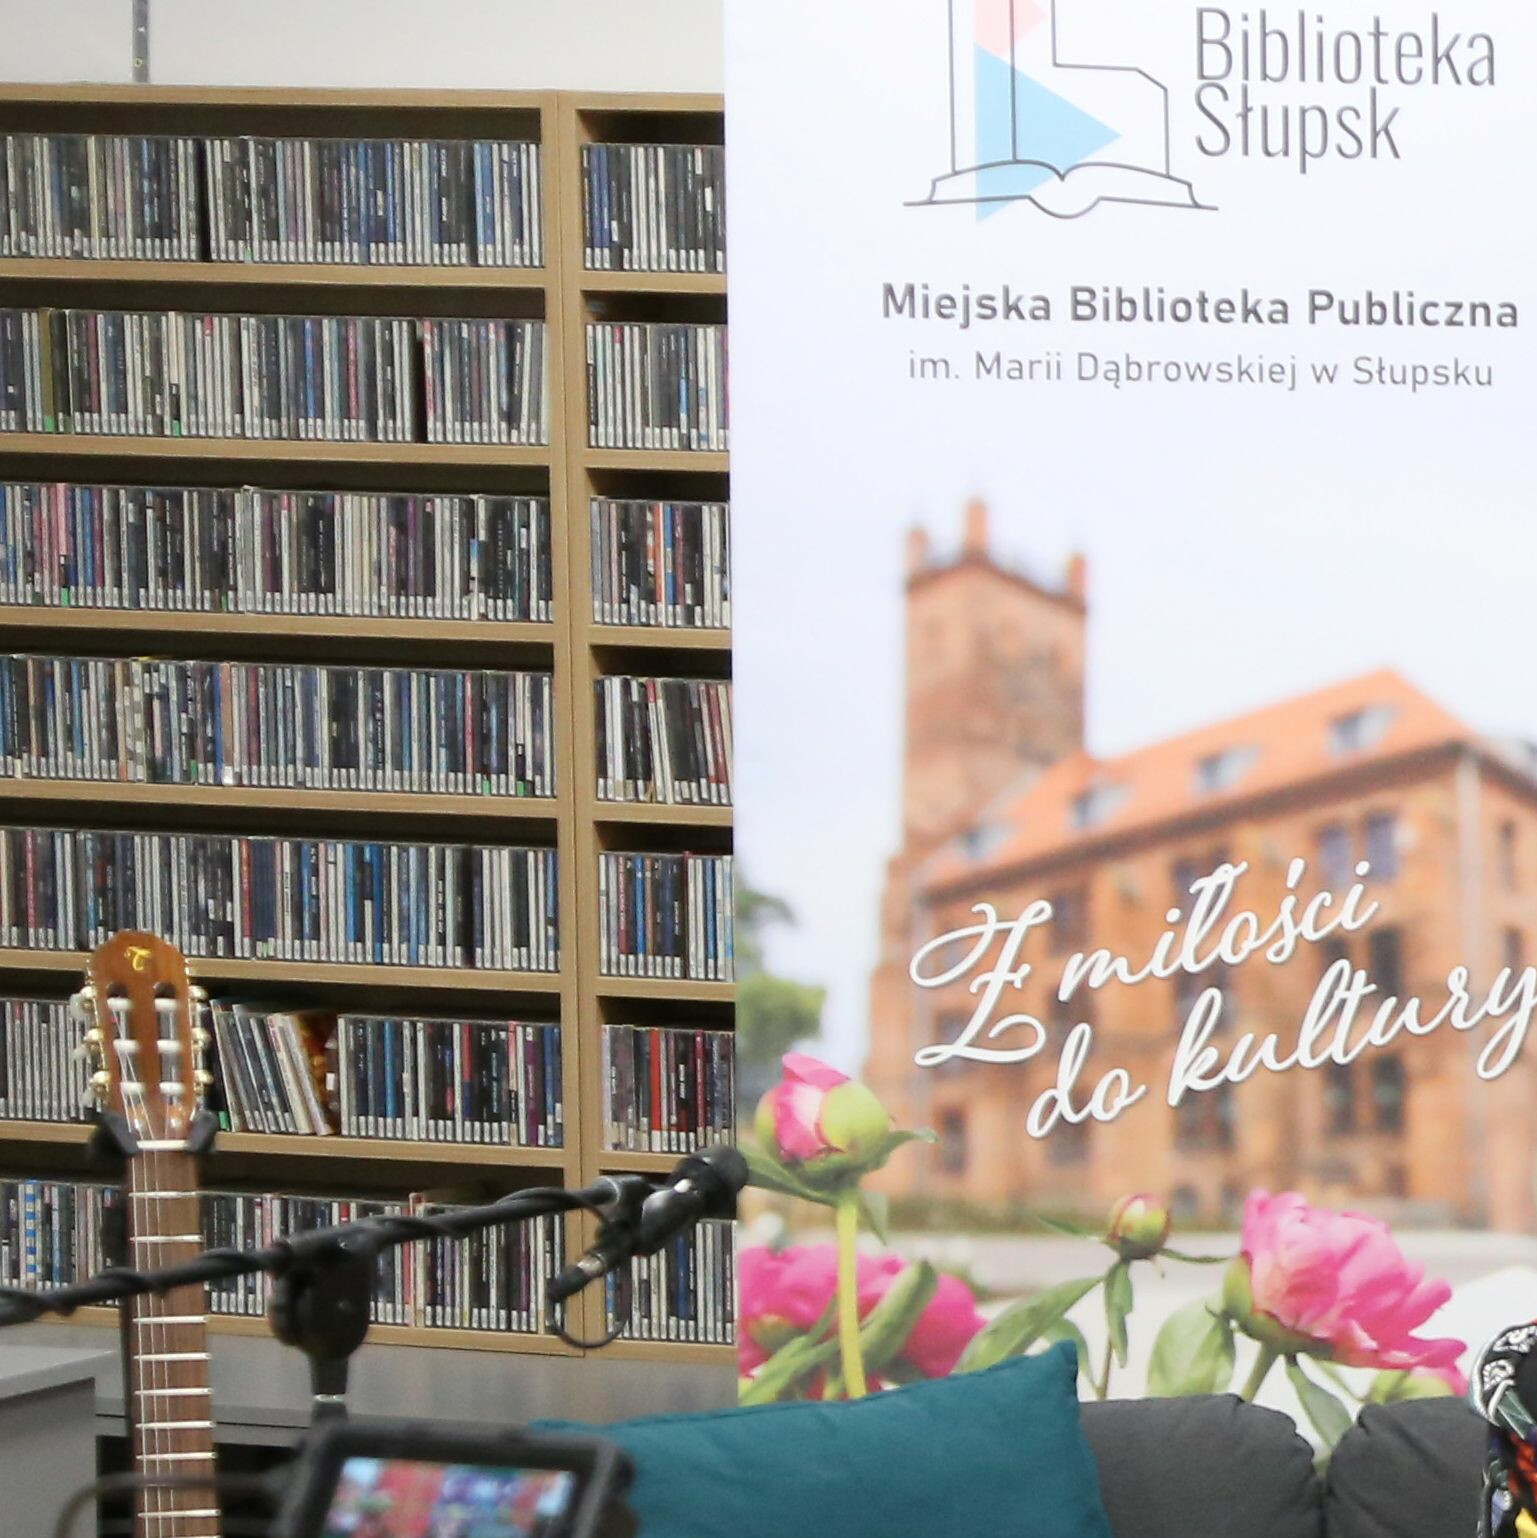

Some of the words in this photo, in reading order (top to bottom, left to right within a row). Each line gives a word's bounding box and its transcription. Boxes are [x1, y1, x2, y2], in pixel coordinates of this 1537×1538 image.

[1196, 8, 1497, 87] Biblioteka
[1195, 83, 1402, 173] Słupsk
[882, 283, 1052, 327] Miejska
[1069, 285, 1290, 327] Biblioteka
[1307, 289, 1520, 331] Publiczna
[908, 350, 960, 381] im.
[974, 351, 1063, 382] Marii
[1077, 351, 1298, 392] Dąbrowskiej
[1312, 362, 1338, 386] w
[1353, 355, 1494, 395] Słupsku
[907, 899, 1053, 1067] Z
[1057, 857, 1381, 1003] miłości
[1026, 1023, 1147, 1140] do
